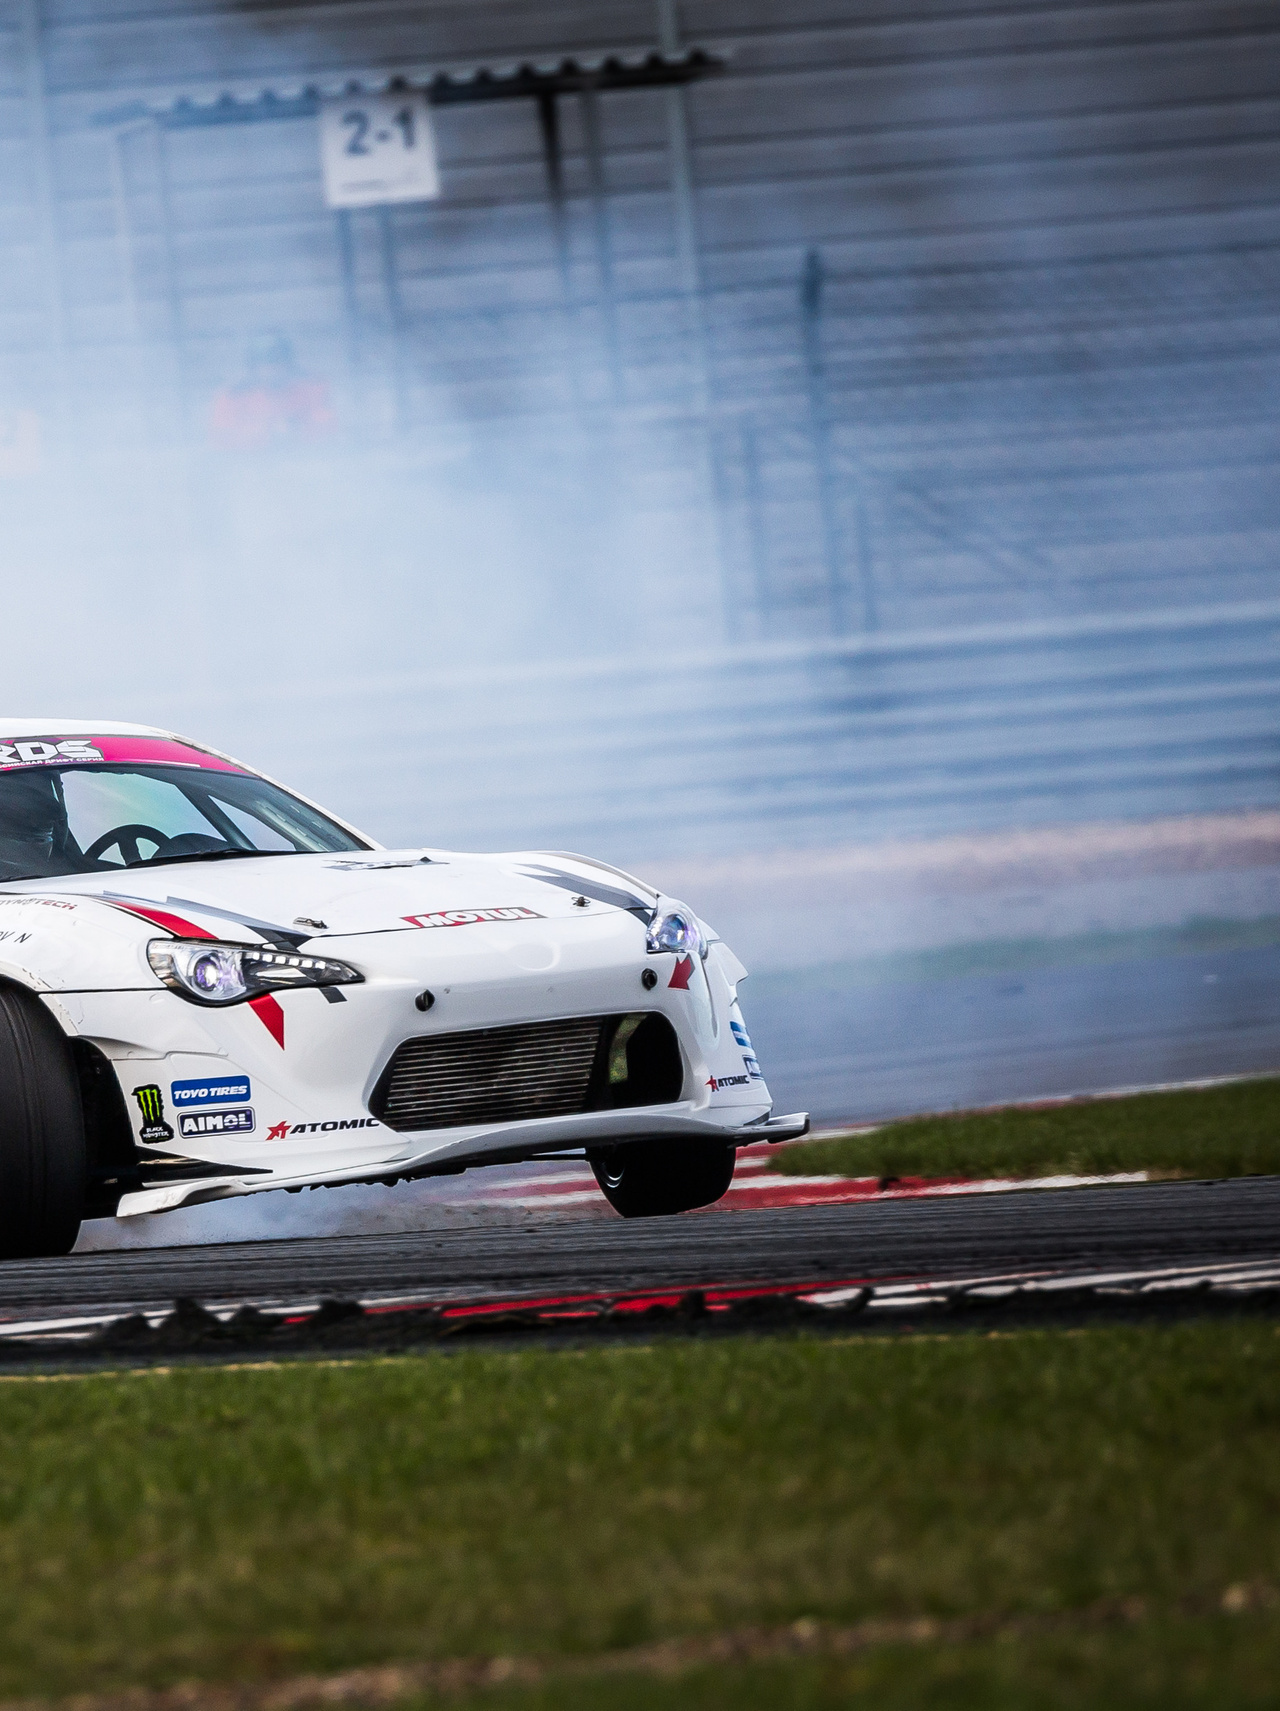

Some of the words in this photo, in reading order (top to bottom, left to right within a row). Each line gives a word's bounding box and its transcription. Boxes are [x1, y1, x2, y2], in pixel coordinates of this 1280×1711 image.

[341, 106, 416, 157] 2-1
[414, 908, 538, 927] MOTUL
[717, 1075, 750, 1088] ATOMIC
[174, 1088, 208, 1100] TOYO
[209, 1085, 248, 1097] TIRES
[183, 1113, 251, 1133] AIMOL
[289, 1117, 380, 1135] ATOMIC
